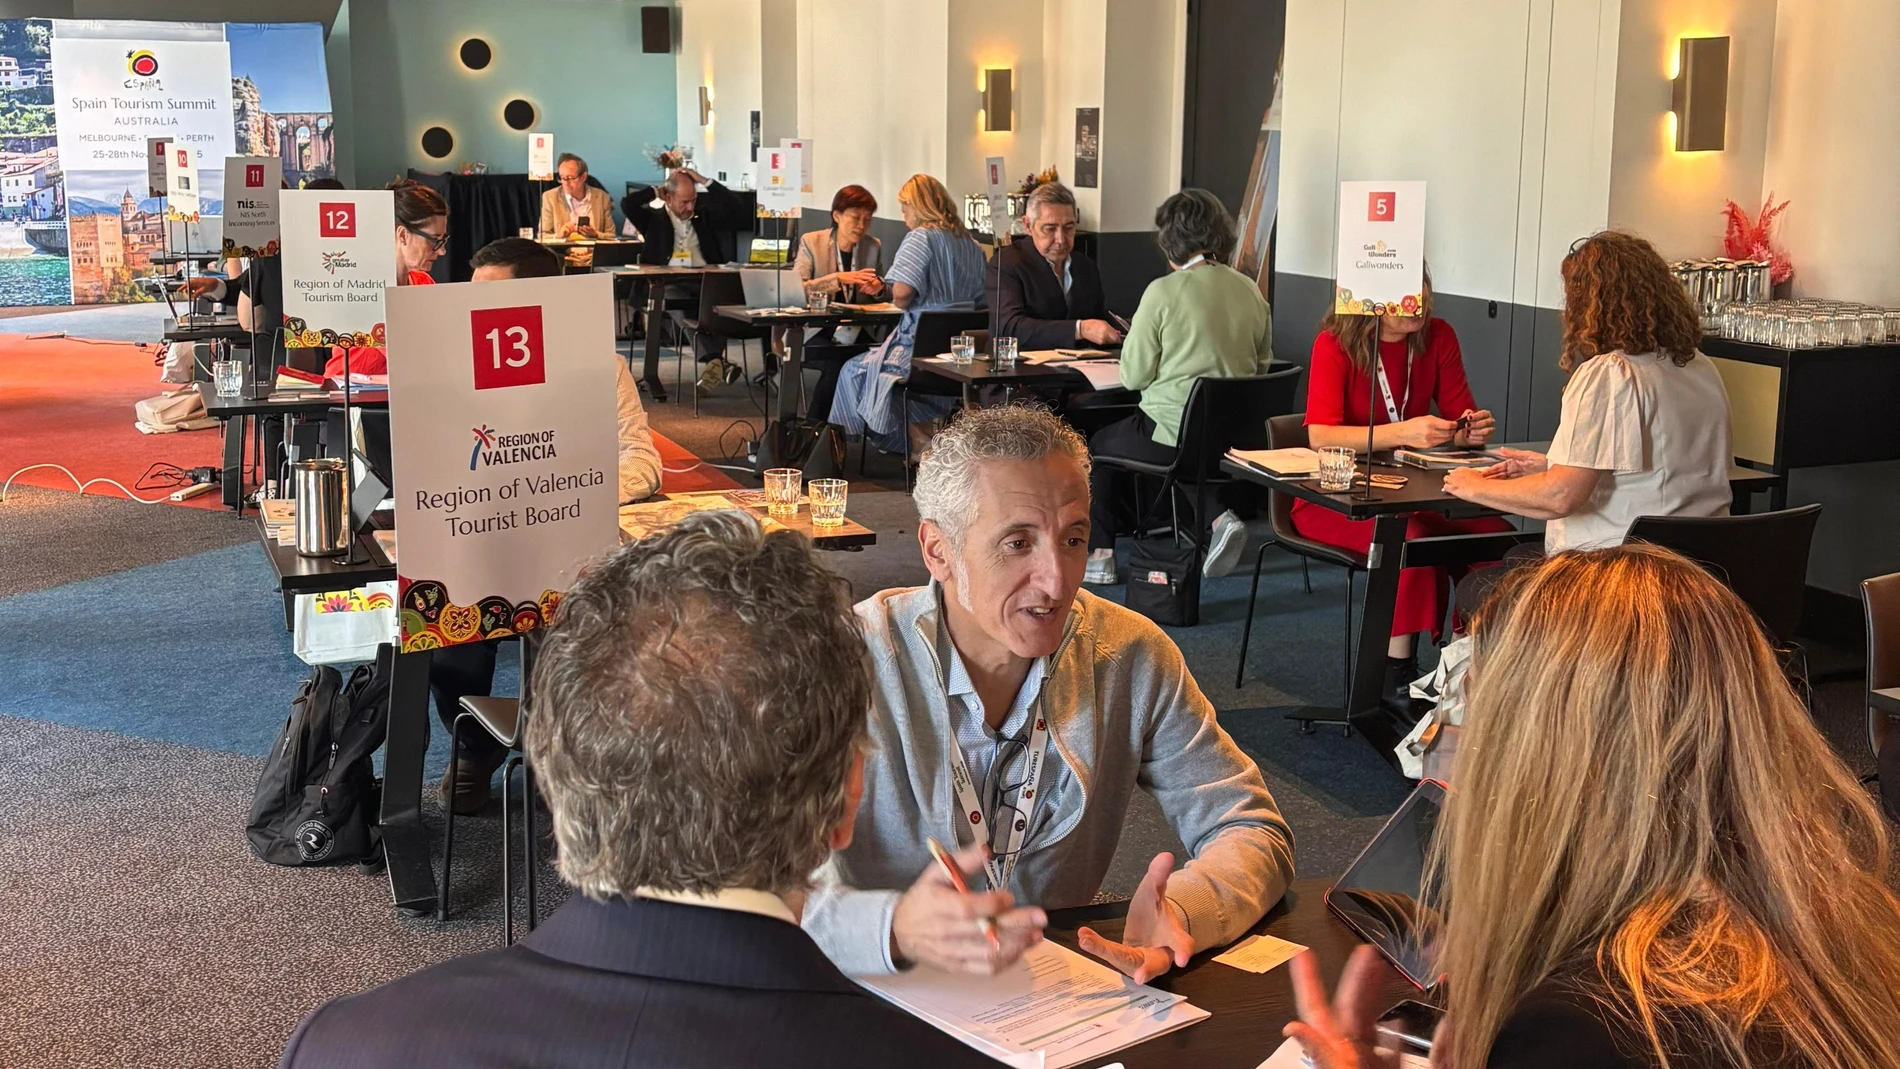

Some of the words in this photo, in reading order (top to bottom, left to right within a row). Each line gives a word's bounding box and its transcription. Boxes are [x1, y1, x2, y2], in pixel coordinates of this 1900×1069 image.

[72, 97, 107, 112] Spain
[111, 98, 163, 110] Tourism
[167, 98, 217, 110] Summit
[114, 117, 179, 126] AUSTRALIA
[79, 134, 137, 142] MELBOURNE
[92, 150, 129, 159] 25-28th
[178, 154, 187, 165] 10
[250, 170, 260, 183] 11
[1376, 199, 1387, 215] 5
[229, 220, 255, 228] Incoming
[326, 211, 349, 230] 12
[293, 279, 330, 291] Region
[333, 279, 344, 289] of
[347, 279, 386, 289] Madrid
[302, 293, 344, 302] Tourism
[347, 293, 378, 302] Board
[485, 325, 532, 369] 13
[498, 432, 540, 449] REGION
[541, 430, 555, 443] OF
[482, 443, 557, 466] VALENCIA
[416, 486, 491, 513] Region
[498, 477, 521, 500] of
[525, 468, 604, 495] Valencia
[445, 510, 519, 537] Tourist
[525, 498, 580, 526] Board
